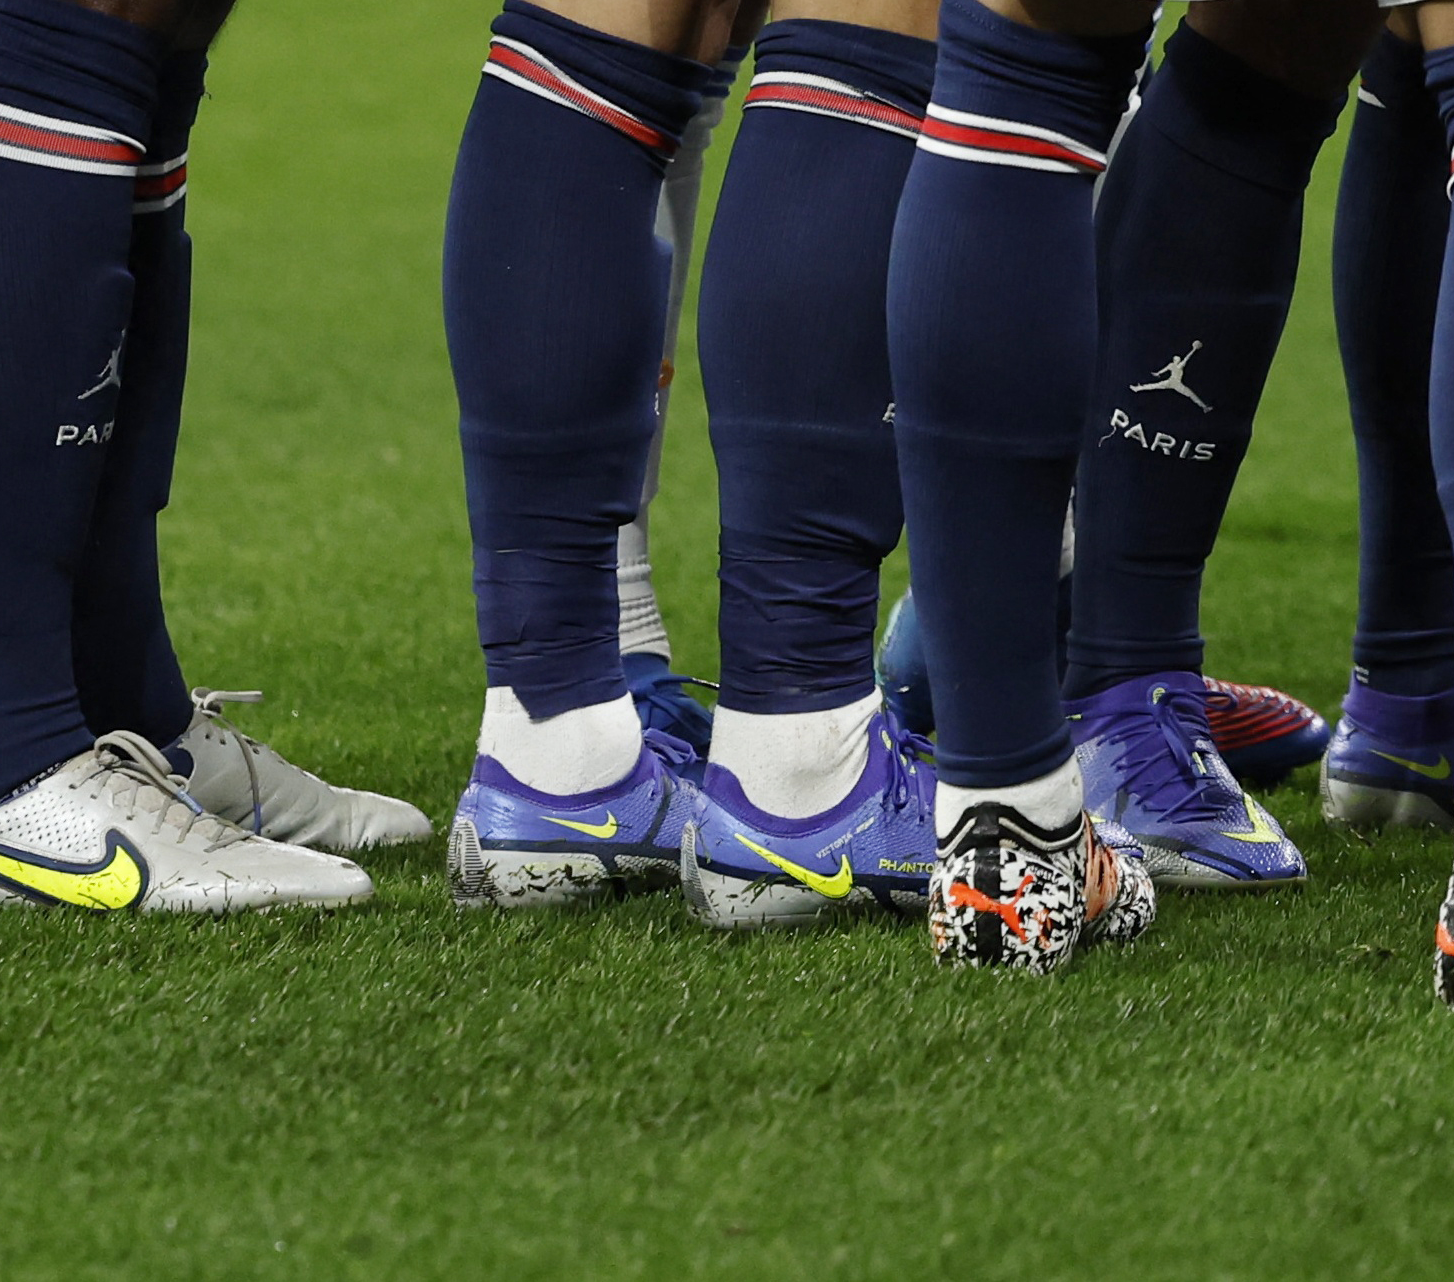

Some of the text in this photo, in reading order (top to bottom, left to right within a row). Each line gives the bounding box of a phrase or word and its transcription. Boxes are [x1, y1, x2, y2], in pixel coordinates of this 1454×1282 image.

[55, 418, 115, 446] PAR
[1110, 408, 1216, 461] PARIS
[878, 858, 936, 874] PHANTO
